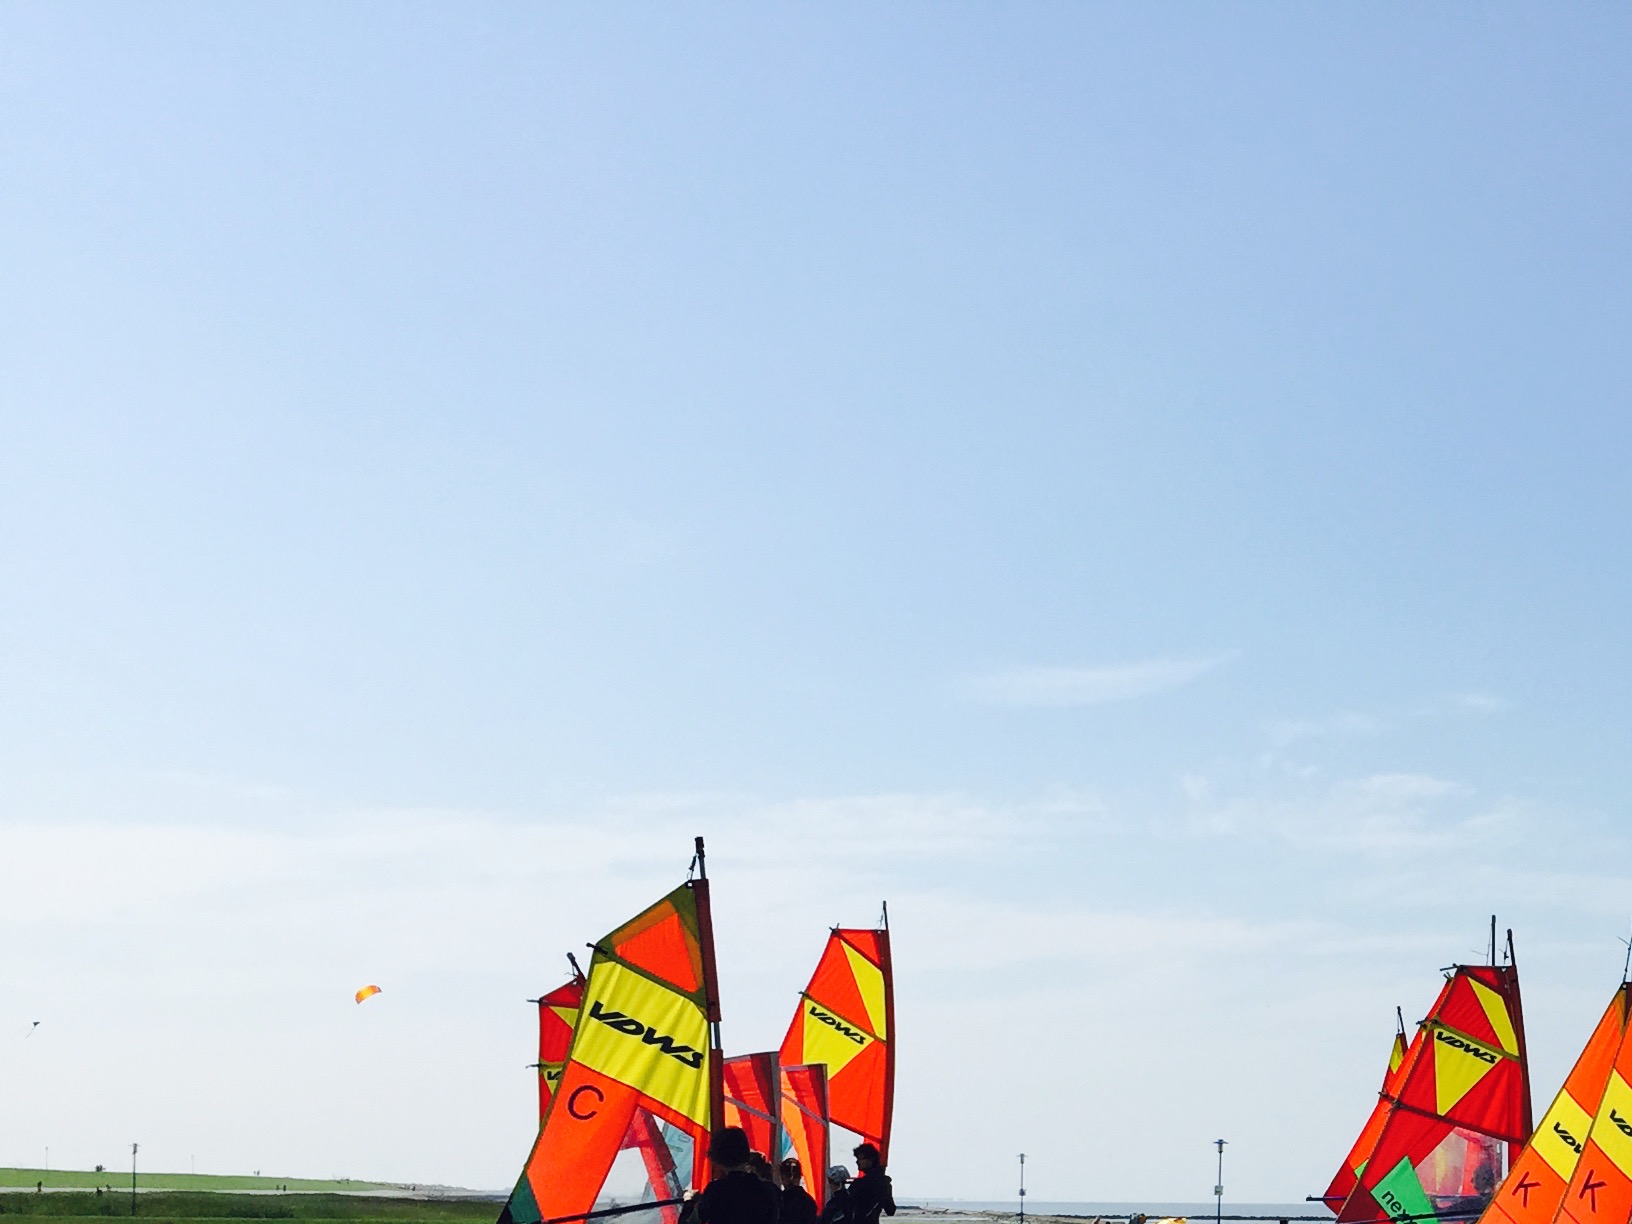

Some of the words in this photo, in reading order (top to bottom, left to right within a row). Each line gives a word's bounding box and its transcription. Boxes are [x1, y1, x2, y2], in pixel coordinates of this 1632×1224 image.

[589, 1000, 704, 1069] VDWS
[809, 1006, 866, 1045] VDWS
[1436, 1031, 1498, 1064] VDWS
[568, 1085, 605, 1121] C
[1512, 1171, 1541, 1209] K
[1579, 1169, 1607, 1213] K
